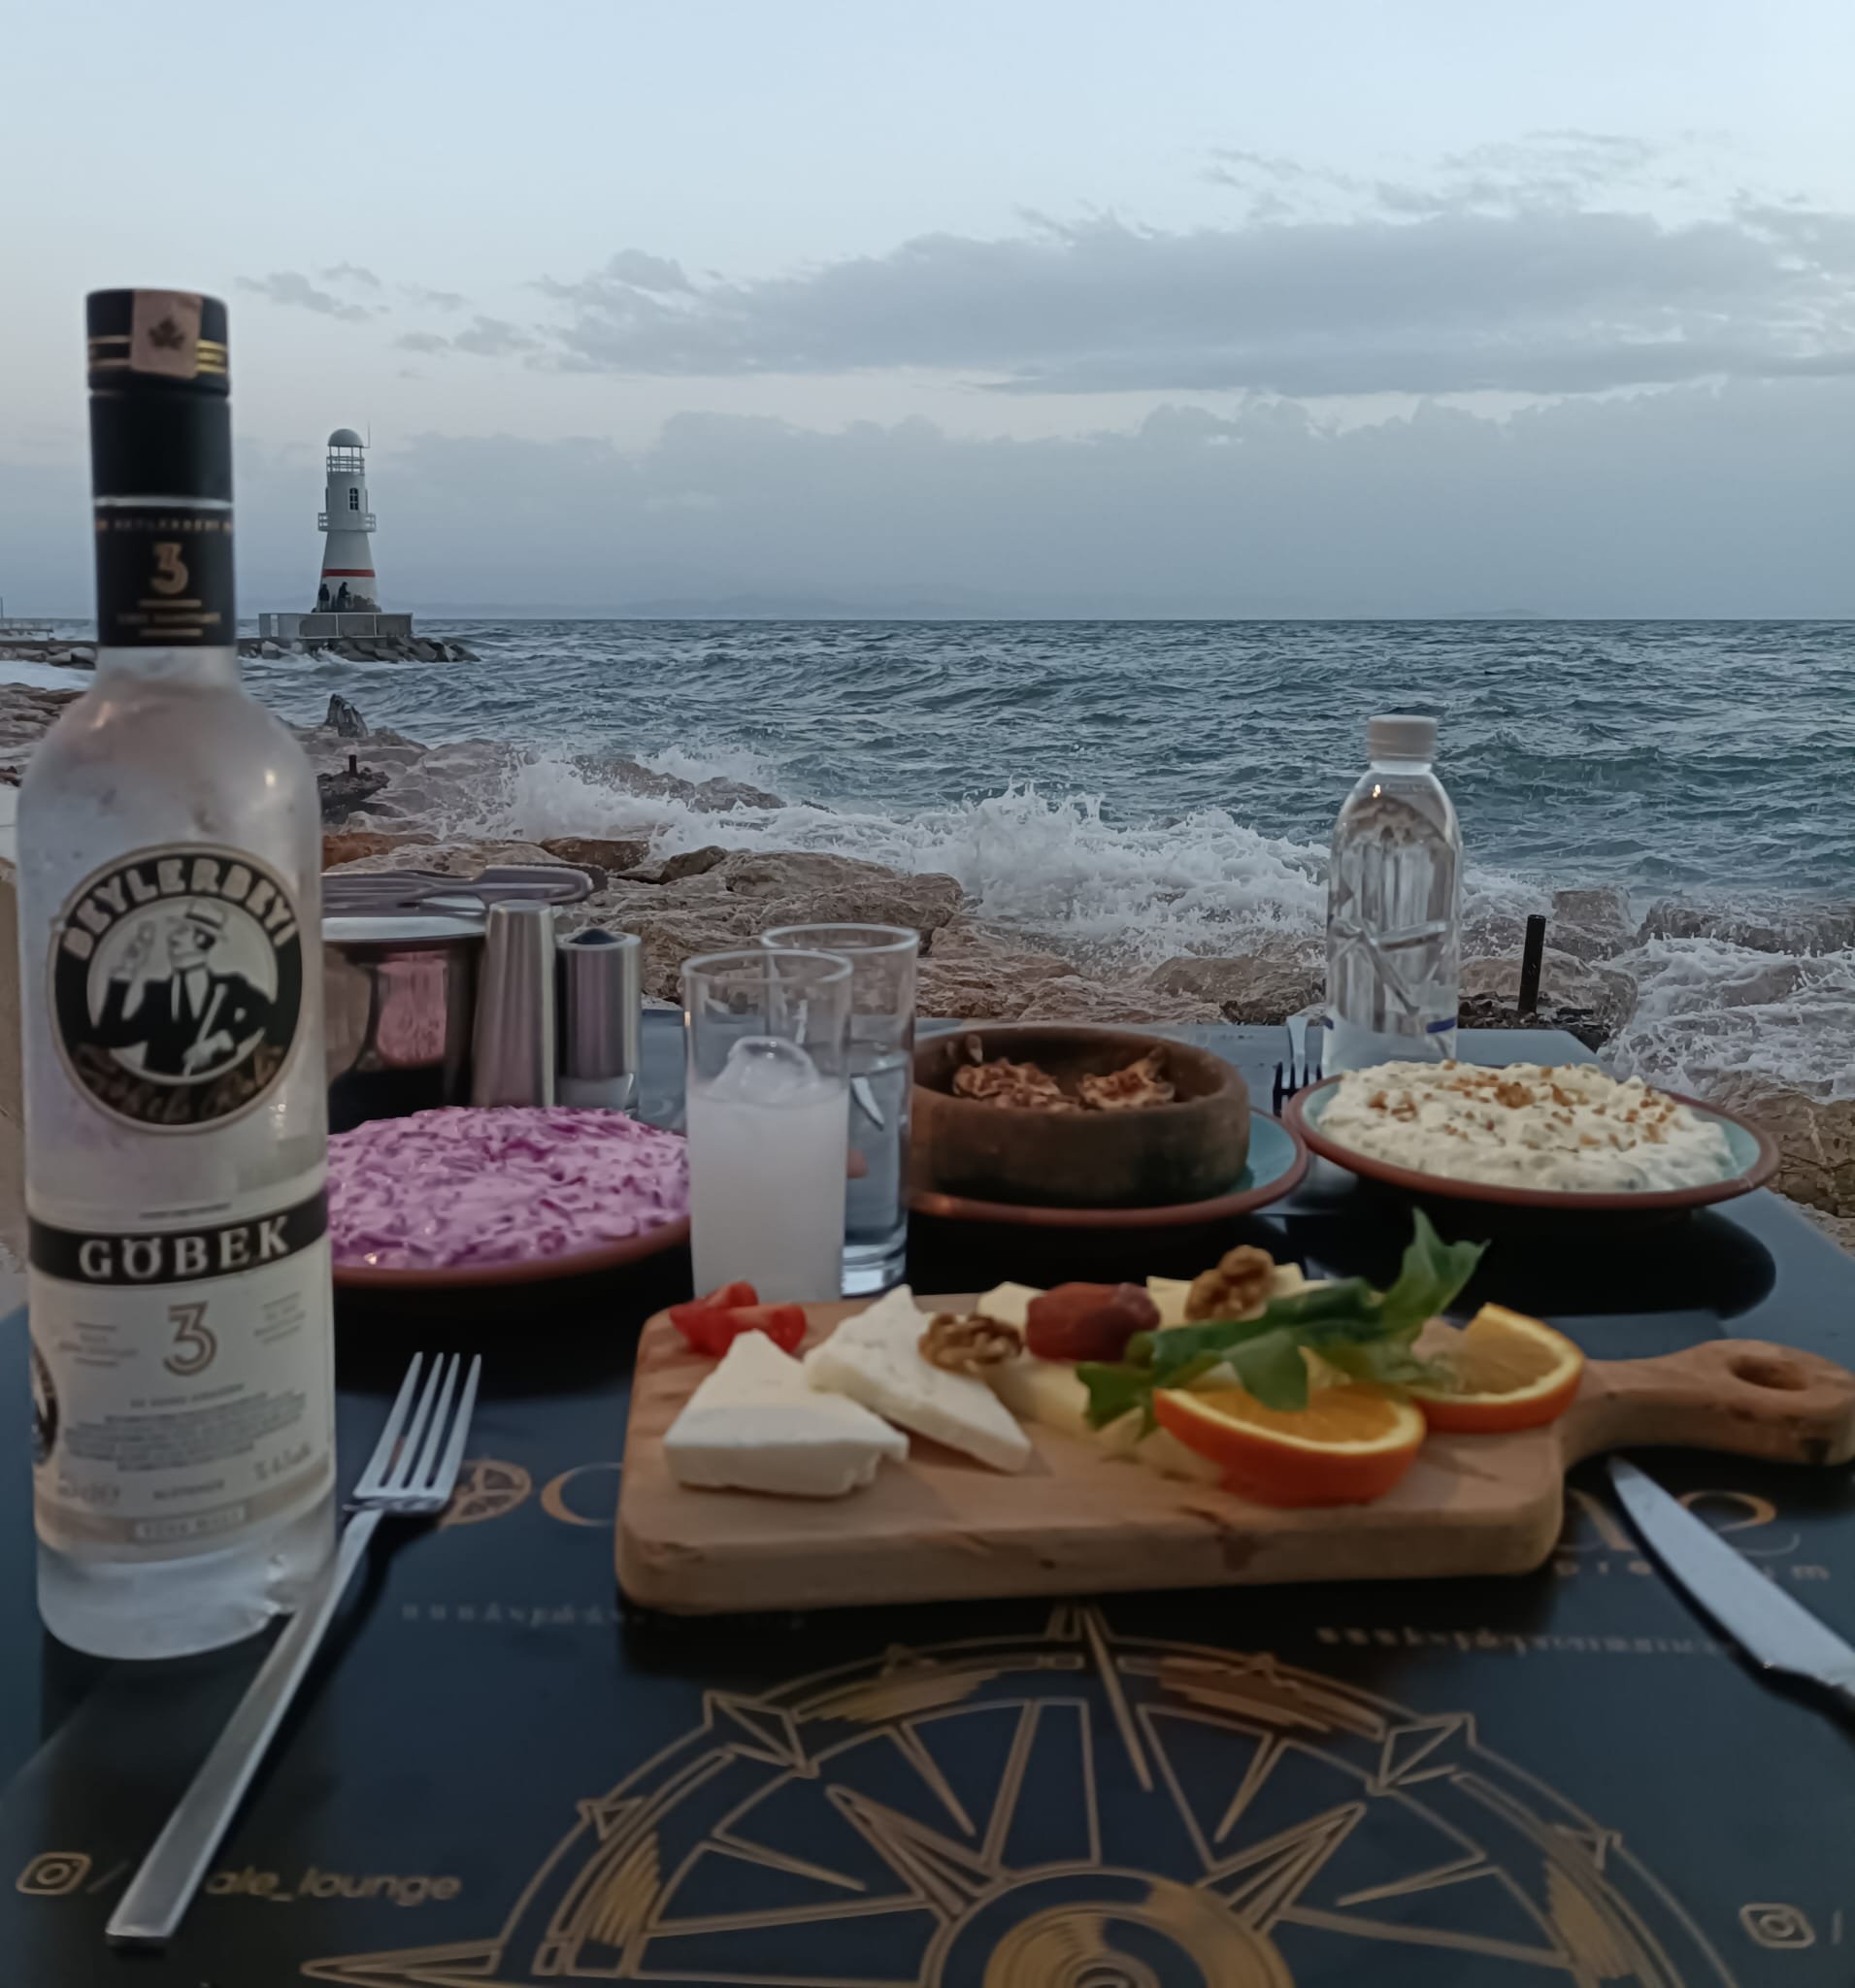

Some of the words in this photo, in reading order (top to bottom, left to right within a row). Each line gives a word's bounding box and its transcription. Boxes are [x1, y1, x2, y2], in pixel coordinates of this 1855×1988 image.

[149, 541, 189, 595] 3
[78, 1214, 289, 1279] GÖBEK
[162, 1300, 217, 1377] 3
[204, 1866, 464, 1907] ale_lounge
